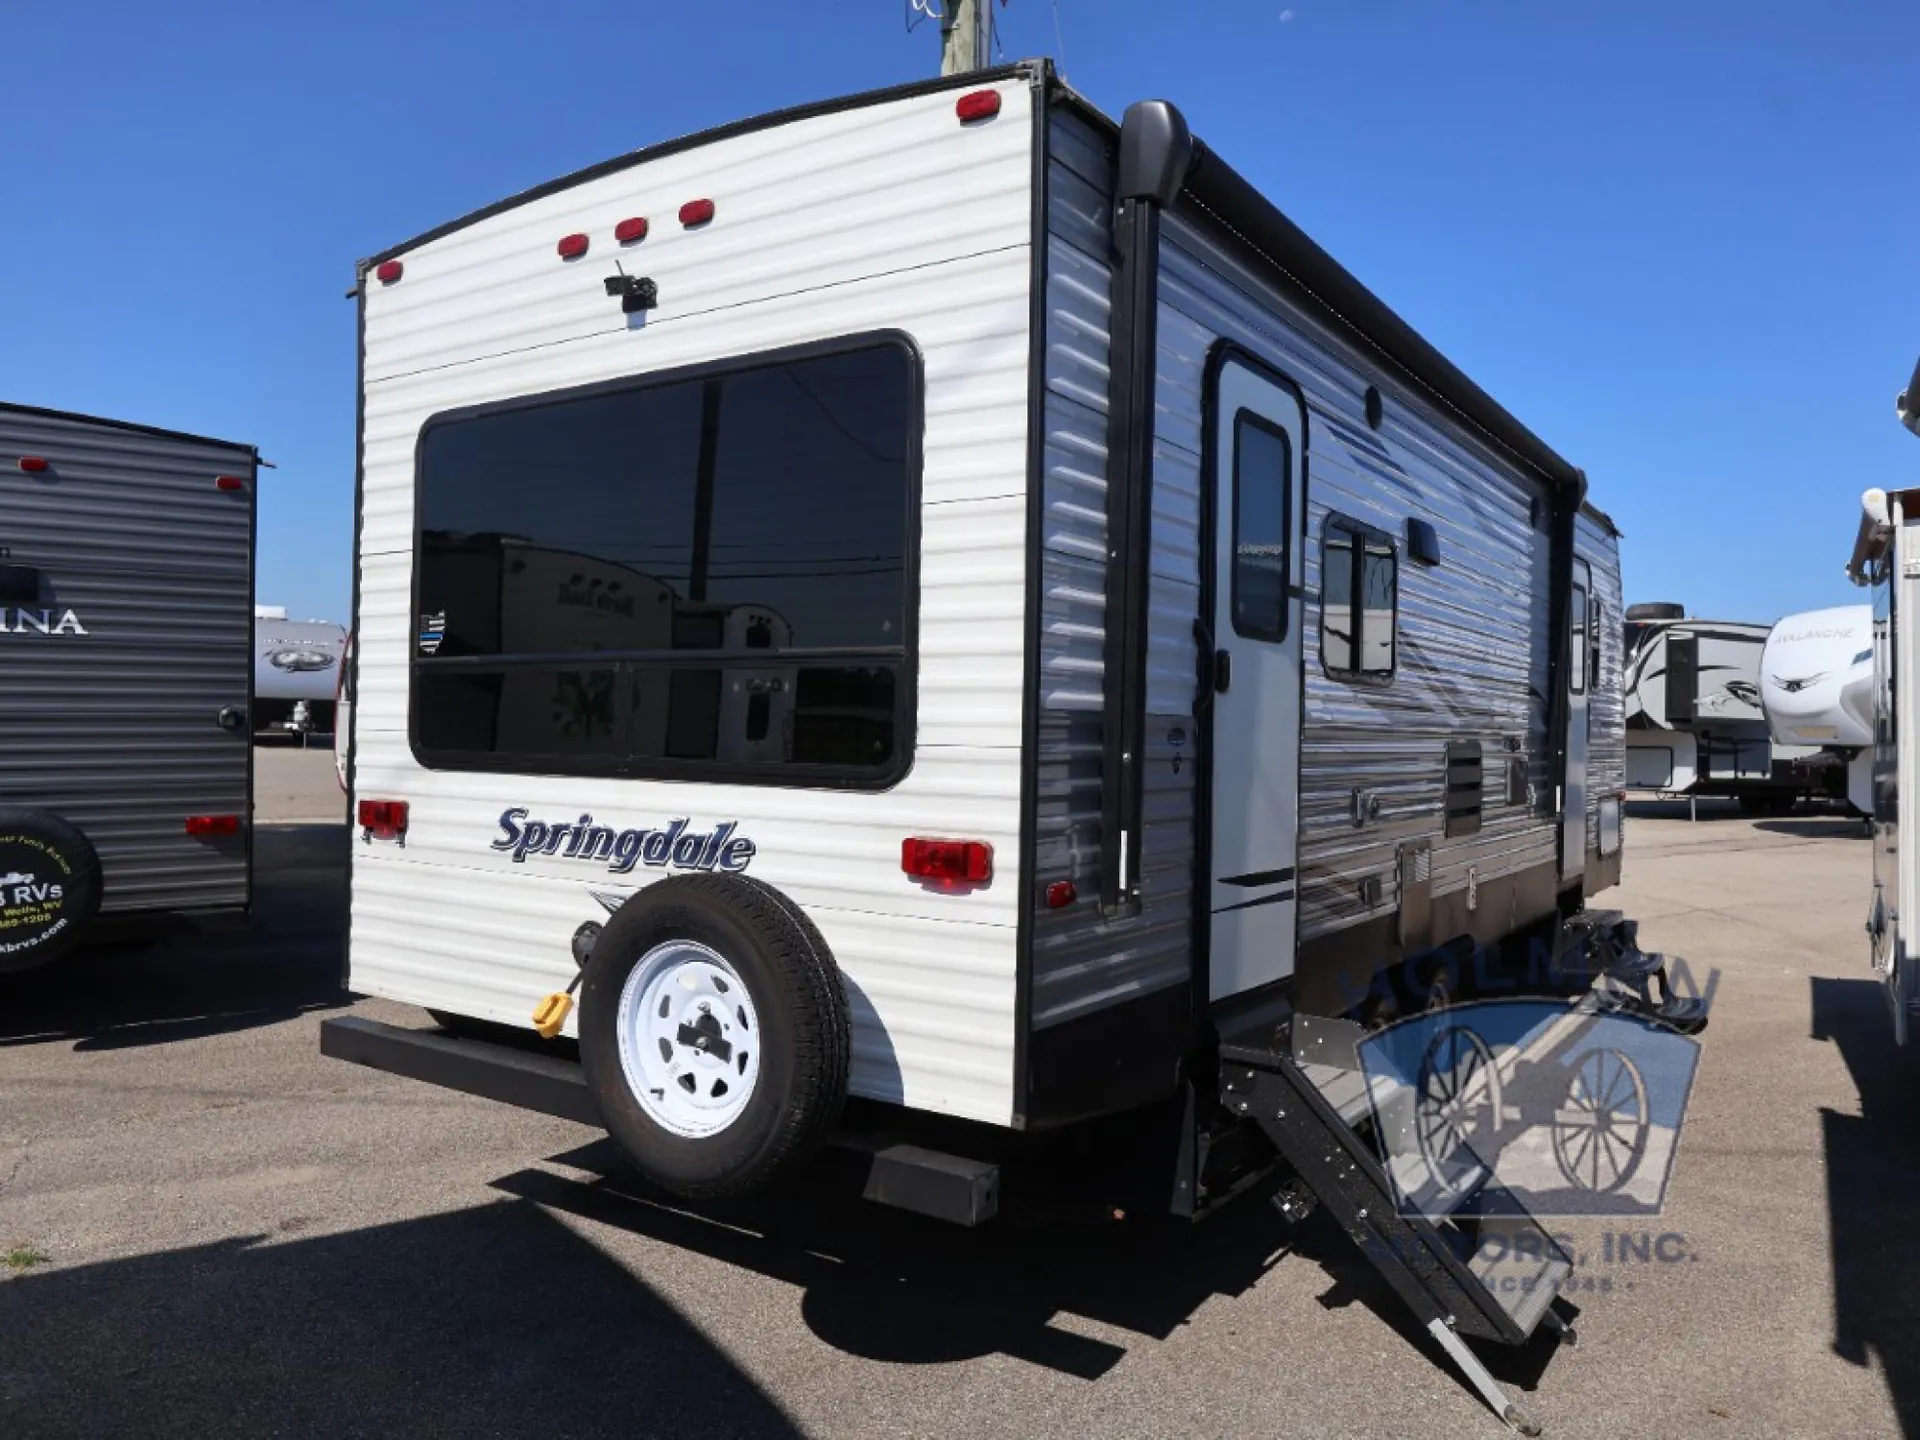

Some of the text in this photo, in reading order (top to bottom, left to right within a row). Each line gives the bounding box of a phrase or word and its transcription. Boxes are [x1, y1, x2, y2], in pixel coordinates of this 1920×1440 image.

[1773, 627, 1855, 644] AVALANCHE
[489, 806, 756, 873] Springdale
[14, 882, 63, 905] RVs
